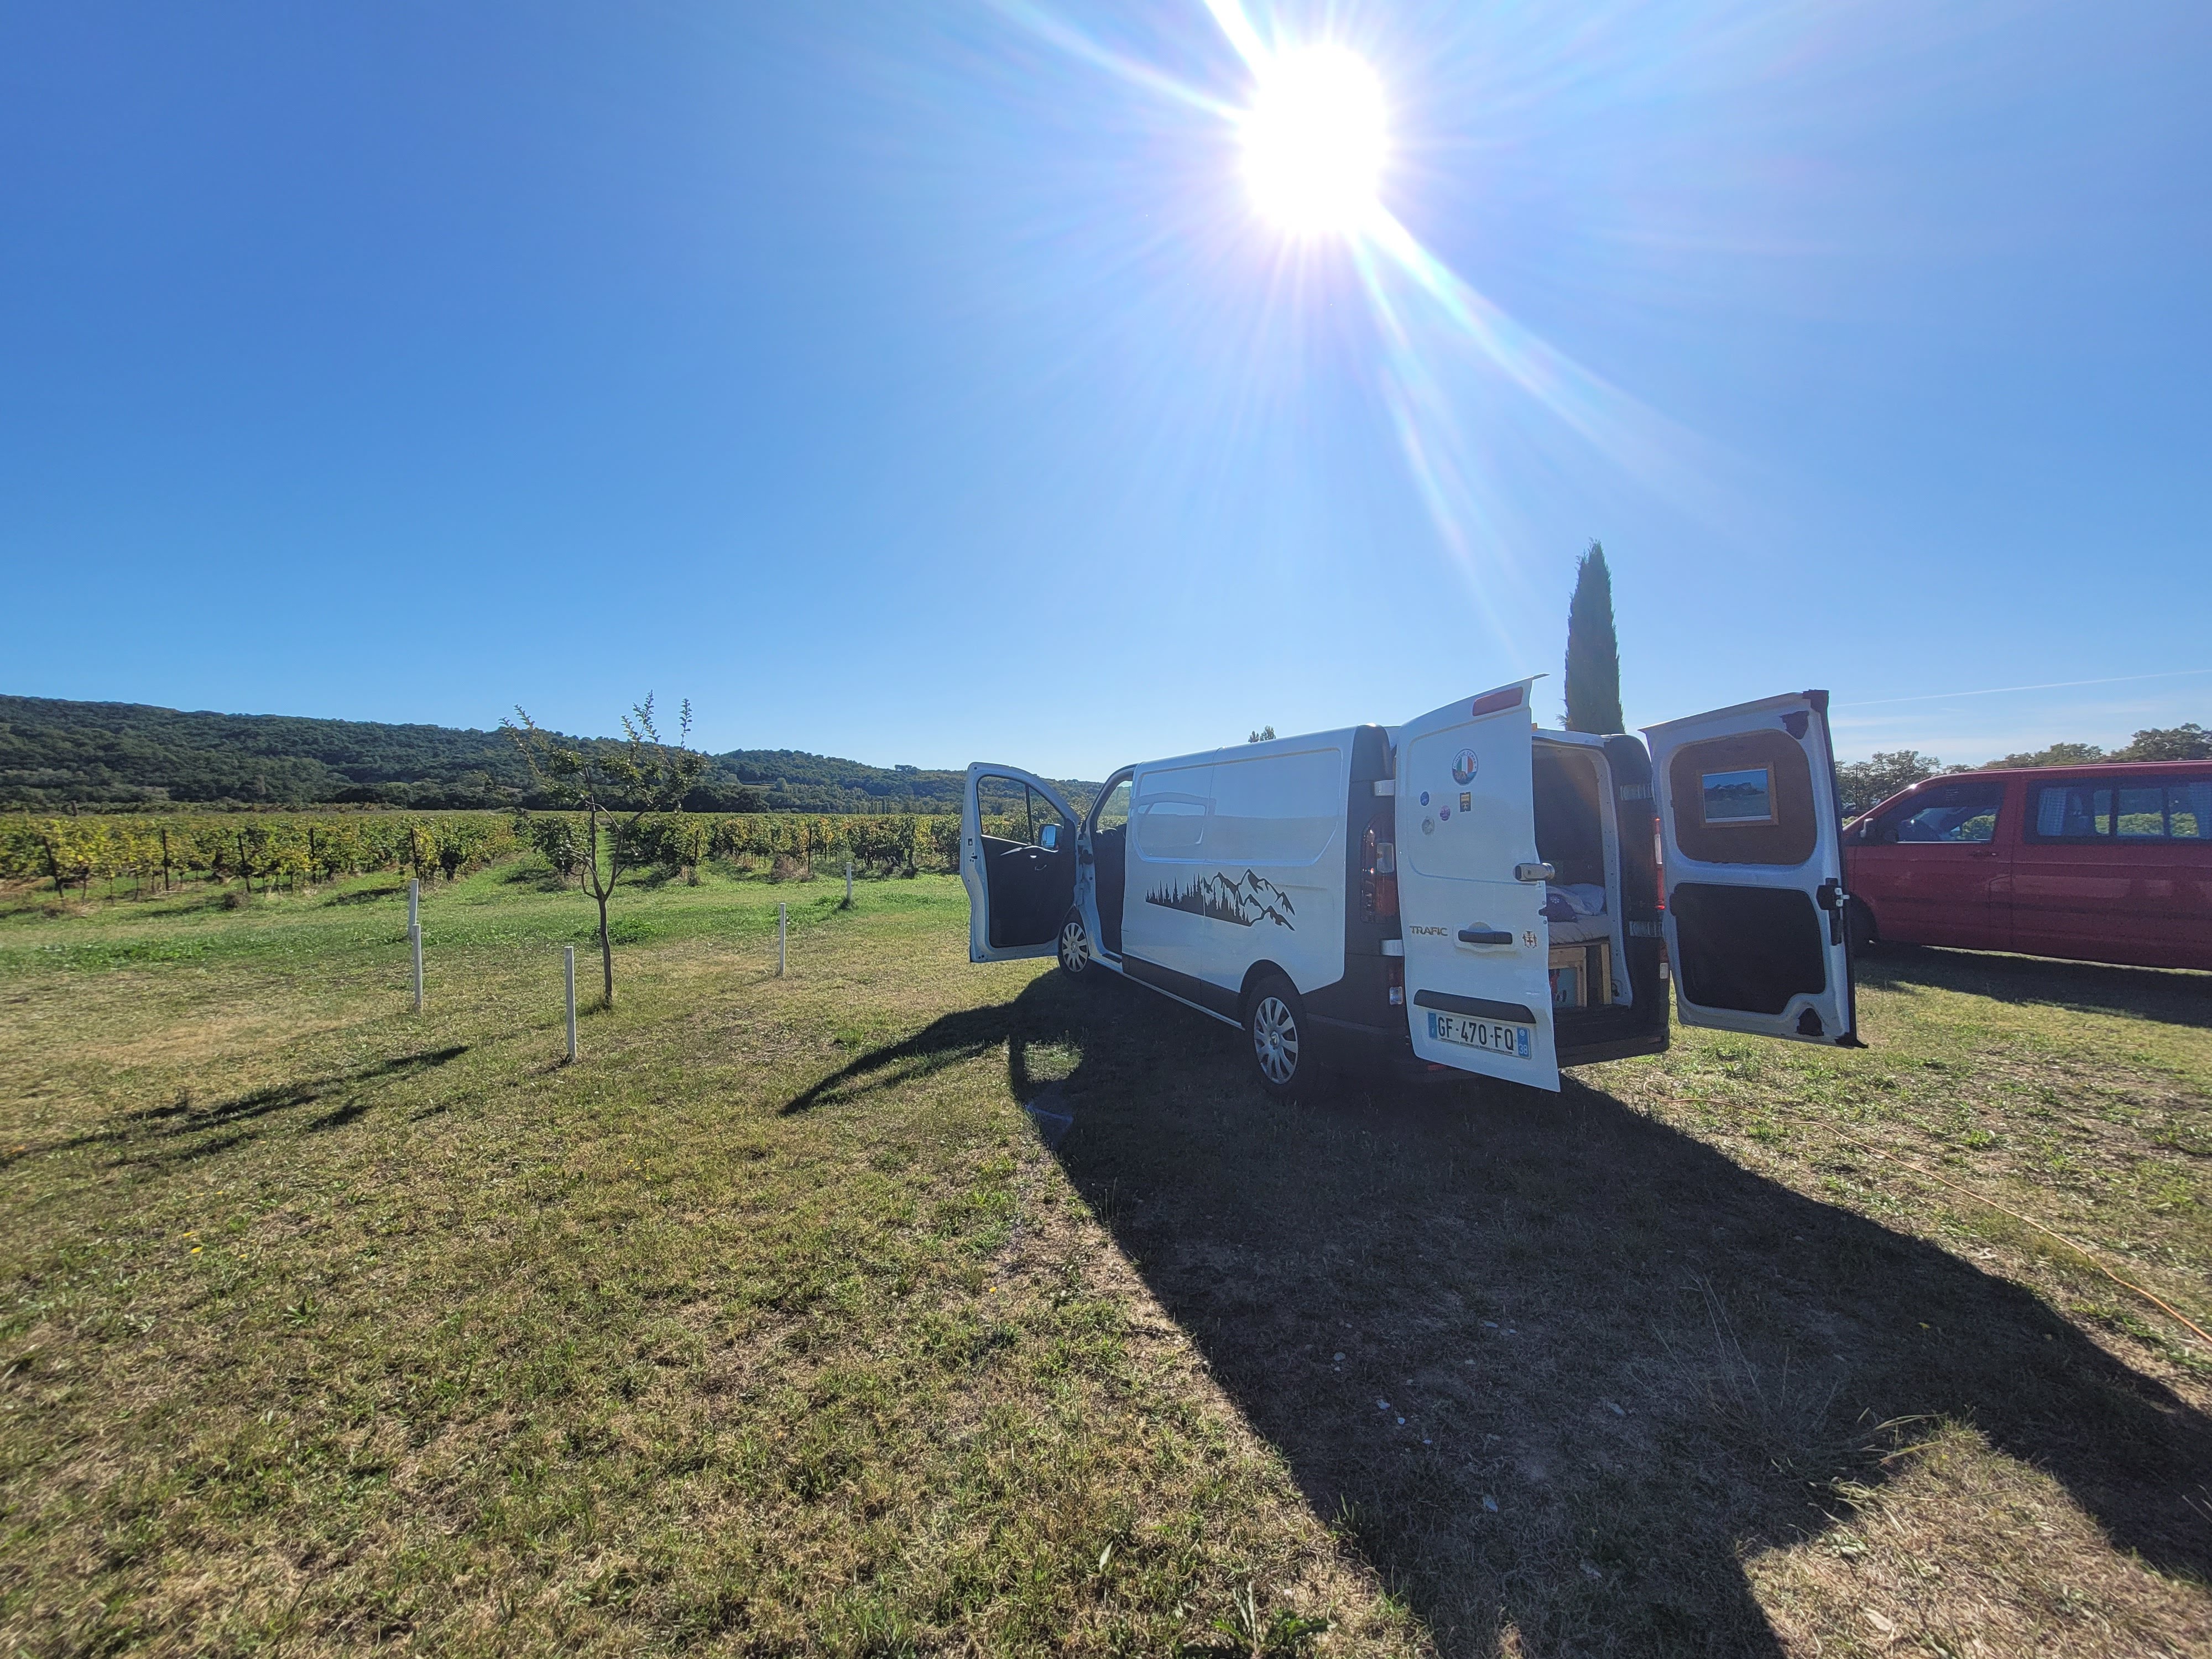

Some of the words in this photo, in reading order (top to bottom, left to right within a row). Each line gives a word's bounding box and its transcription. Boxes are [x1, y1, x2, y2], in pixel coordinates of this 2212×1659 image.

[1409, 925, 1448, 936] TRAFIC
[1438, 1016, 1514, 1051] GF-470-FQ
[1519, 1044, 1528, 1055] 38
